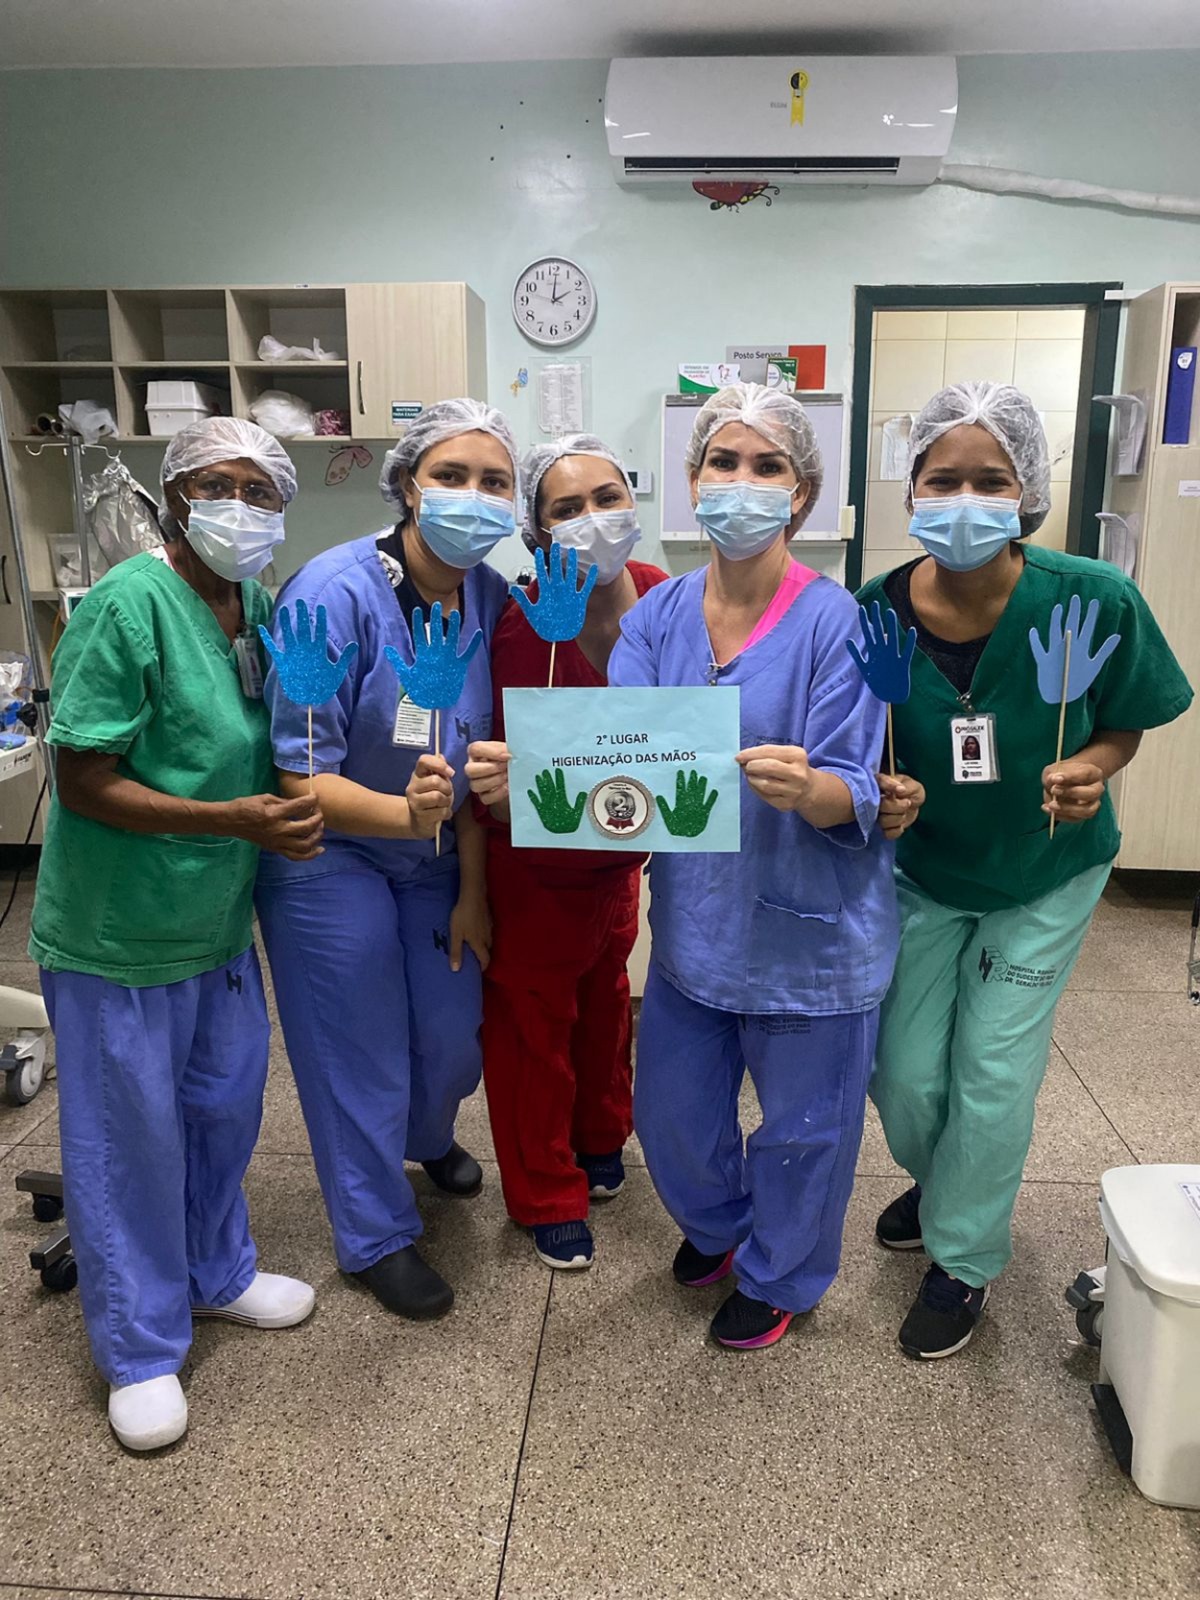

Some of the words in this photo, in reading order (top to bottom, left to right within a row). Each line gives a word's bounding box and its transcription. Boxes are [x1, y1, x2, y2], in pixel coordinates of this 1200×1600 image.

[536, 271, 544, 280] 11
[548, 265, 560, 276] 12
[566, 270, 570, 279] 1
[526, 282, 537, 293] 10
[574, 280, 582, 291] 2
[520, 295, 529, 306] 9
[578, 295, 586, 306] 3
[525, 310, 535, 321] 8
[573, 309, 581, 320] 4
[536, 321, 544, 332] 7
[549, 324, 558, 336] 6
[564, 321, 572, 332] 5
[733, 351, 754, 359] Posto
[610, 733, 648, 745] LUGAR
[551, 753, 633, 767] HIGIENIZAÇÃO
[635, 753, 658, 763] DAS
[661, 749, 696, 762] MÃOS
[614, 796, 627, 811] 2
[1009, 964, 1036, 974] HOSPITAL
